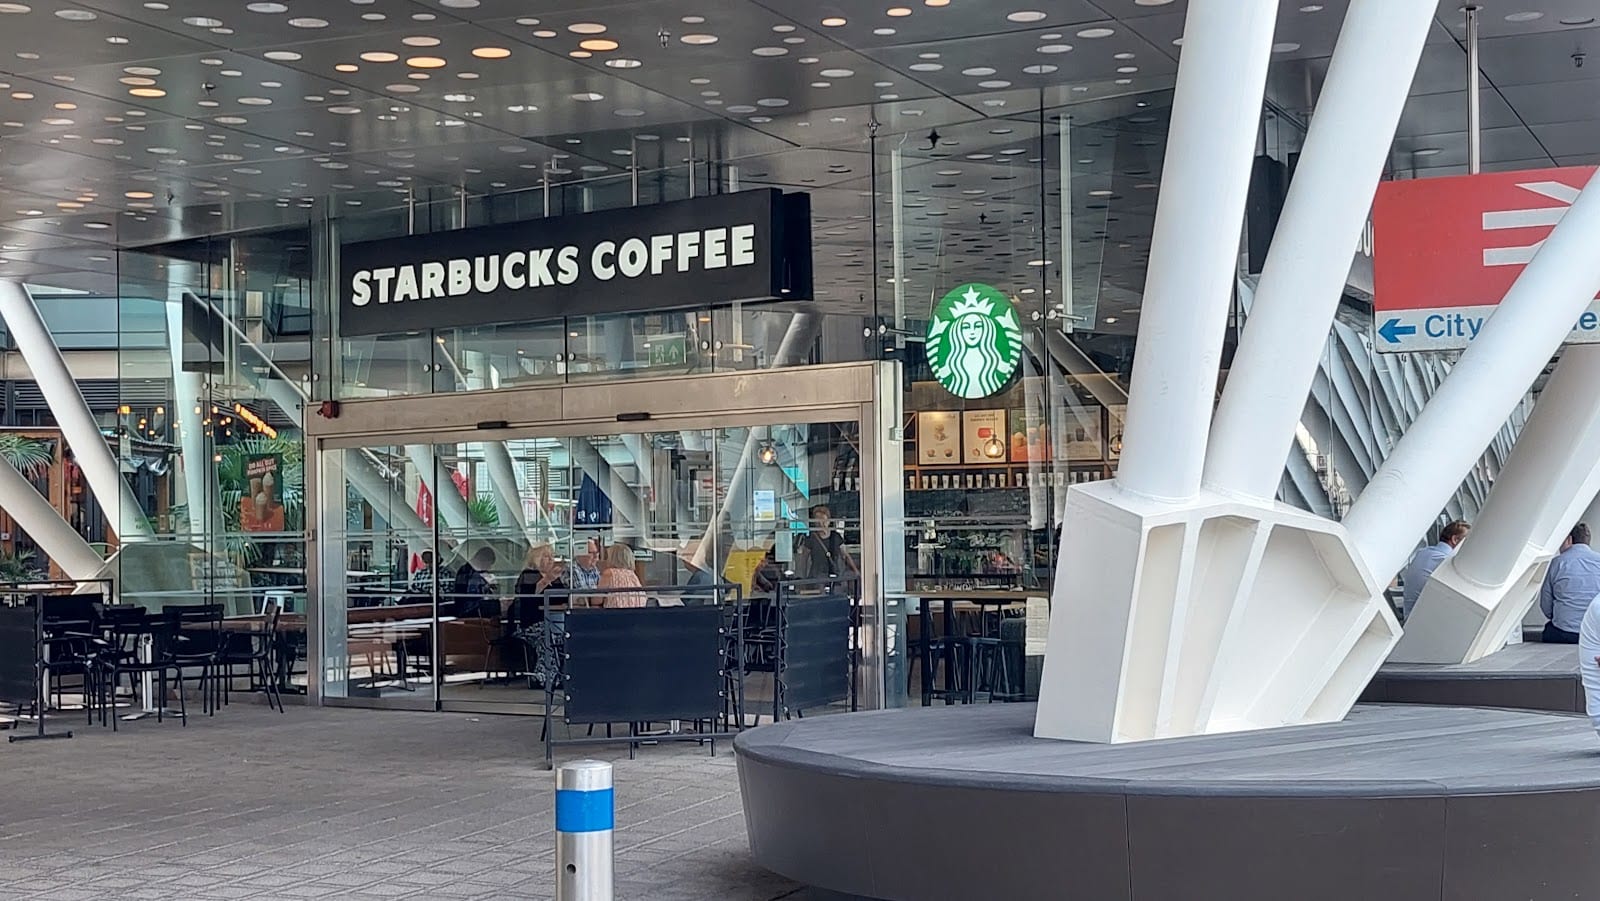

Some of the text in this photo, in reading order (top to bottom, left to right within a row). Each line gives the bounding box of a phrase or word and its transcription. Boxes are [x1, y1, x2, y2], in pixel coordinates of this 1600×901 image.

[352, 224, 755, 307] STARBUCKS COFFEE
[1425, 313, 1483, 341] City
